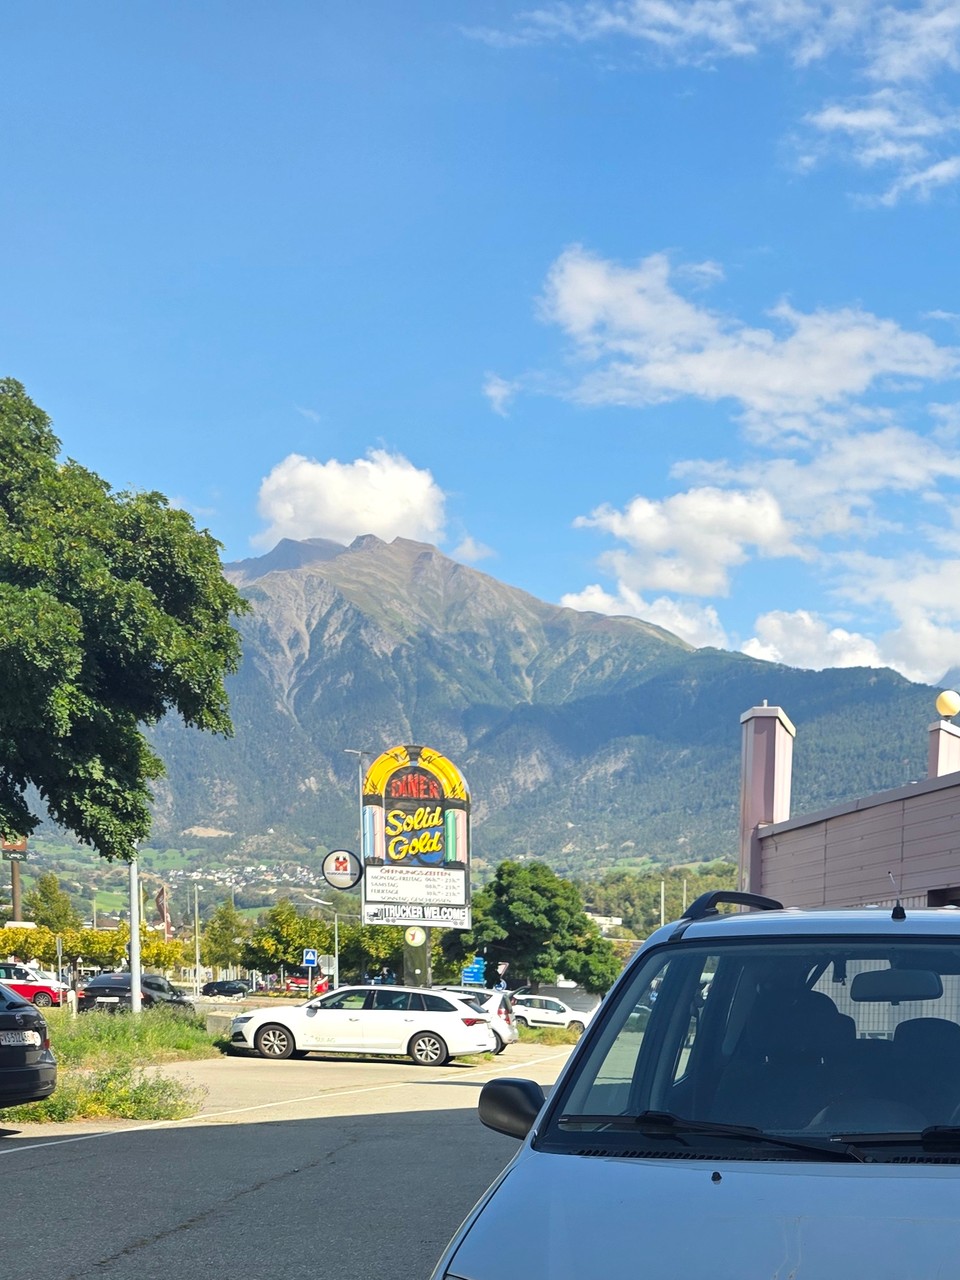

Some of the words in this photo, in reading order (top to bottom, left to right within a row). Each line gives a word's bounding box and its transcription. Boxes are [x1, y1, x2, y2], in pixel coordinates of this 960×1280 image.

[392, 774, 440, 799] DINER
[385, 806, 443, 836] Solid
[388, 831, 442, 860] Gold
[380, 868, 451, 877] ÖFFNUNGSZEITEN
[384, 905, 423, 918] TRUCKER
